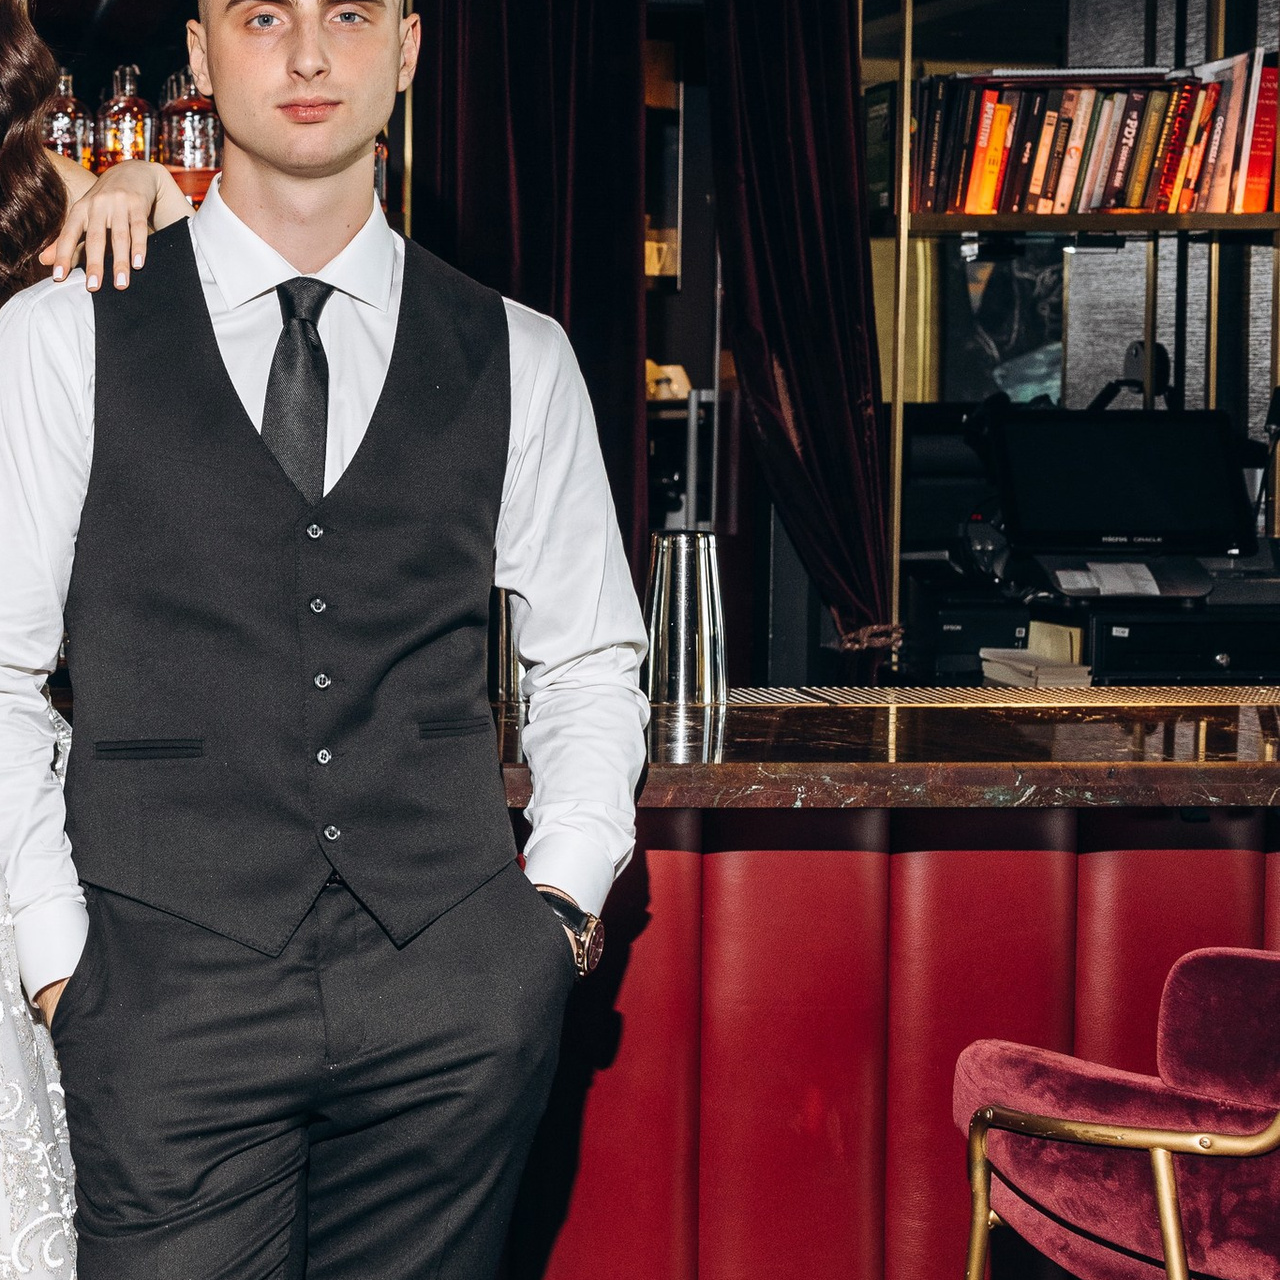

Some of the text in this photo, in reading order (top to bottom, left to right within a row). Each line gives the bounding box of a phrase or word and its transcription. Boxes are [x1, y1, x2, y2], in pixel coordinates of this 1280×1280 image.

[977, 101, 995, 148] APERITIVO
[1121, 117, 1138, 147] PDT
[1156, 151, 1181, 198] BOOK
